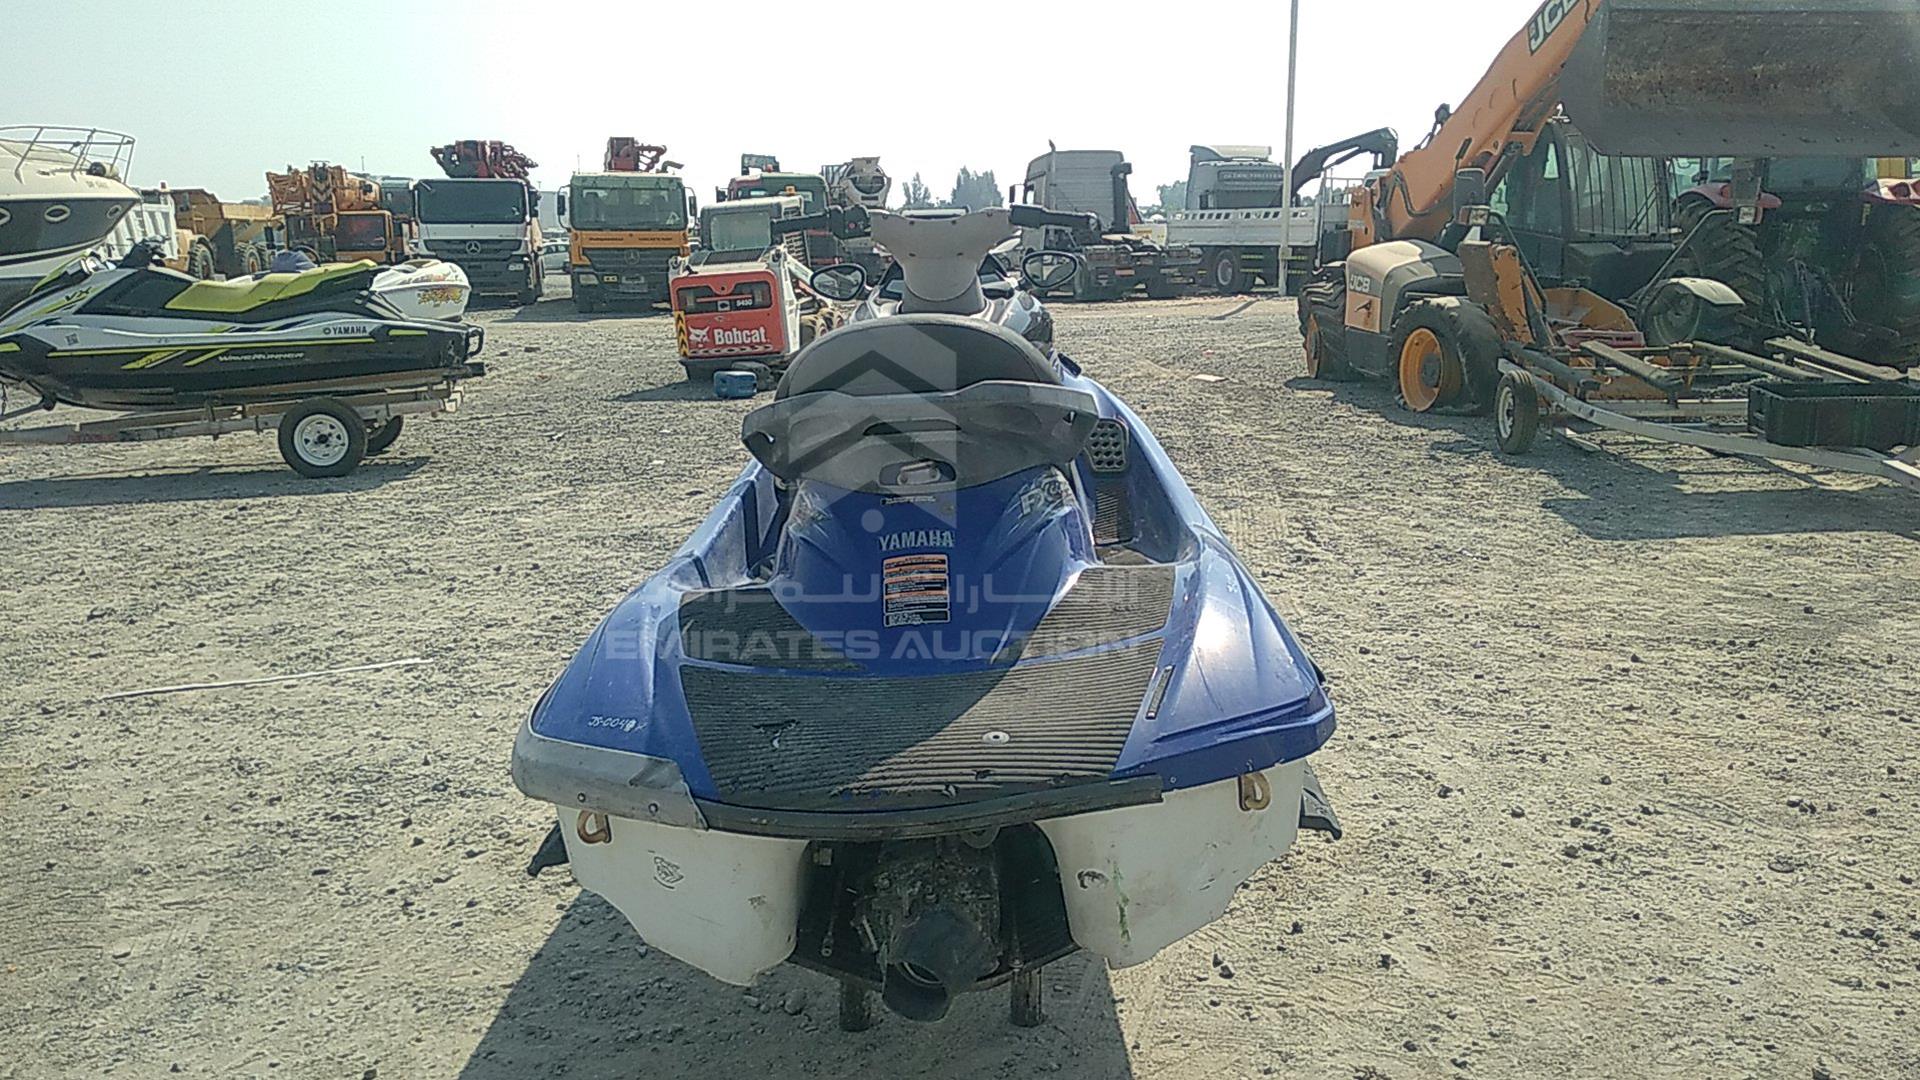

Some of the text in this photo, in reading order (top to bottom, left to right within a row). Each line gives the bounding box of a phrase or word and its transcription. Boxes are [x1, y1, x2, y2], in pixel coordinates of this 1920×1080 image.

[1350, 273, 1371, 294] JCB
[332, 325, 368, 336] YAMAHA
[713, 326, 767, 345] Bobcat
[879, 529, 955, 552] YAMAHA
